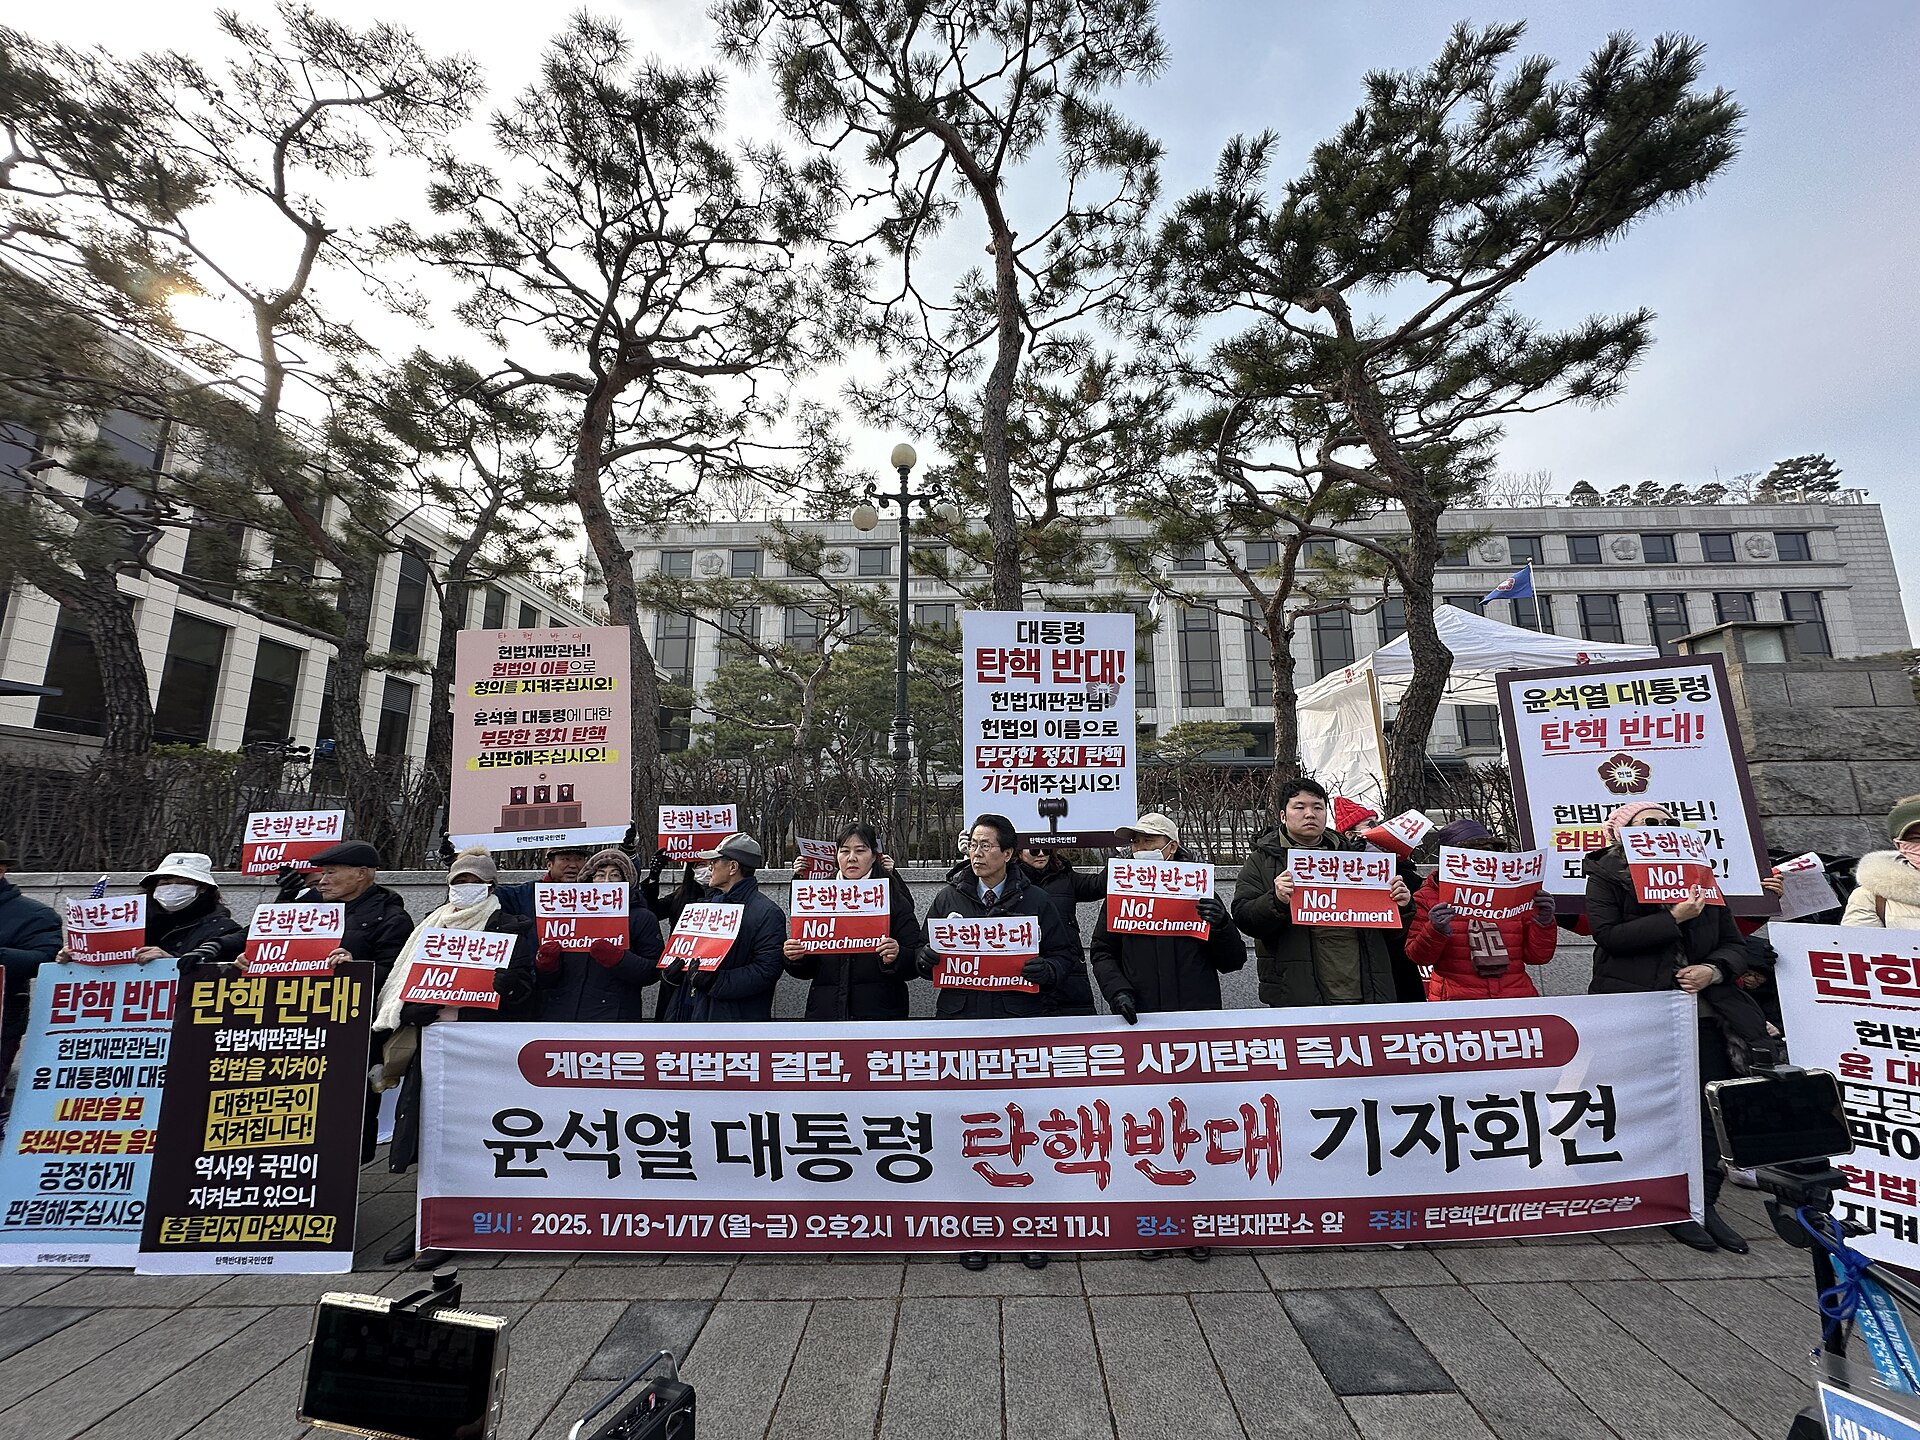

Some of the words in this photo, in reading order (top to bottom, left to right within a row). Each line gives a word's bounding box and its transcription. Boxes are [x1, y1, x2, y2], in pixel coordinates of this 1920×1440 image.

[1016, 620, 1086, 645] 대통령
[498, 644, 591, 659] 헌법재판관님!
[492, 661, 537, 676] 헌법의
[540, 660, 596, 675] 이름으로
[976, 648, 1041, 684] 탄핵
[1052, 649, 1126, 684] 반대!
[474, 680, 518, 695] 정의를
[521, 677, 613, 693] 지켜주십시오!
[1522, 683, 1611, 714] 윤석열
[1616, 674, 1712, 706] 대통령
[990, 690, 1110, 712] 헌법재판관님!
[474, 710, 518, 726] 윤석열
[522, 709, 581, 724] 대통령에
[584, 707, 612, 721] 대한
[480, 729, 531, 746] 부당한
[535, 728, 568, 744] 정치
[572, 726, 608, 742] 탄핵
[980, 719, 1038, 740] 헌법의
[1044, 719, 1120, 740] 이름으로
[1540, 718, 1608, 751] 탄핵
[1619, 712, 1706, 747] 반대!
[478, 747, 606, 768] 심판해주십시오!
[978, 747, 1037, 767] 부당한
[1041, 747, 1079, 768] 정치
[1085, 746, 1123, 767] 탄핵
[980, 774, 1120, 795] 기각해주십시오!
[252, 815, 339, 838] 탄핵반대
[662, 808, 732, 830] 탄핵반대
[254, 843, 287, 862] No!
[667, 835, 694, 851] No!
[1628, 831, 1708, 859] 탄핵반대
[1113, 864, 1208, 893] 탄핵반대
[1294, 854, 1390, 882] 탄핵반대
[1446, 853, 1543, 882] 탄핵반대
[1647, 865, 1685, 887] No!
[539, 887, 623, 912] 탄핵반대
[796, 884, 884, 911] 탄핵반대
[1120, 898, 1154, 919] No!
[1303, 889, 1338, 909] No!
[1454, 888, 1495, 908] No!
[256, 908, 340, 933] 탄핵반대
[680, 907, 739, 933] 탄핵반대
[1297, 908, 1394, 924] Impeachment
[1449, 900, 1536, 920] mpeachment
[544, 919, 577, 938] No!
[802, 918, 836, 938] No!
[934, 922, 1033, 949] 탄핵반대
[1112, 916, 1208, 933] Impeachment
[70, 934, 88, 952] No!
[255, 940, 290, 962] No!
[423, 933, 509, 963] 탄핵반대
[669, 937, 699, 956] No!
[248, 957, 330, 975] Impeachment
[946, 957, 980, 976] No!
[418, 968, 457, 989] No!
[50, 979, 116, 1025] 탄핵
[191, 976, 266, 1025] 탄핵
[275, 977, 361, 1024] 반대!
[406, 986, 498, 1003] Impeachment
[57, 1037, 166, 1060] 헌법재판관님!
[215, 1028, 327, 1052] 헌법재판관님!
[544, 1051, 646, 1080] 계엄은
[655, 1052, 760, 1083] 헌법적
[770, 1051, 851, 1083] 결단,
[866, 1043, 1125, 1081] 헌법재판관들은
[1137, 1038, 1287, 1074] 사기탄핵
[1296, 1034, 1371, 1069] 즉시
[1380, 1027, 1544, 1065] 각하하라!
[1838, 1052, 1874, 1081] 윤
[33, 1067, 52, 1090] 윤
[55, 1066, 135, 1090] 대통령에
[209, 1056, 266, 1082] 헌법을
[270, 1055, 327, 1081] 지켜야
[58, 1097, 144, 1121] 내란음모
[214, 1087, 315, 1118] 대한민국이
[208, 1115, 312, 1146] 지켜집니다!
[483, 1107, 698, 1180] 윤석열
[711, 1110, 934, 1183] 대통령
[960, 1093, 1283, 1191] 탄핵반대
[1309, 1083, 1624, 1176] 기자회견
[39, 1162, 135, 1191] 공정하게
[195, 1153, 254, 1180] 역사와
[259, 1153, 318, 1179] 국민이
[188, 1187, 259, 1210] 지켜보고
[263, 1184, 316, 1208] 있으니
[1837, 1163, 1920, 1208] 헌법
[4, 1200, 145, 1226] 판결해주십시오
[531, 1213, 592, 1236] 2025.
[805, 1214, 892, 1239] 오후2시
[905, 1214, 1005, 1239] 1/18(토)
[1011, 1215, 1059, 1238] 오전
[1064, 1215, 1111, 1238] 11시
[1137, 1214, 1185, 1237] 장소:
[1192, 1211, 1314, 1239] 헌법재판소
[1321, 1210, 1345, 1234] 앞
[1368, 1208, 1419, 1230] 주최:
[1424, 1195, 1641, 1229] 탄핵반대범국민연합
[163, 1217, 244, 1242] 흔들리지
[246, 1216, 333, 1240] 마십시오!
